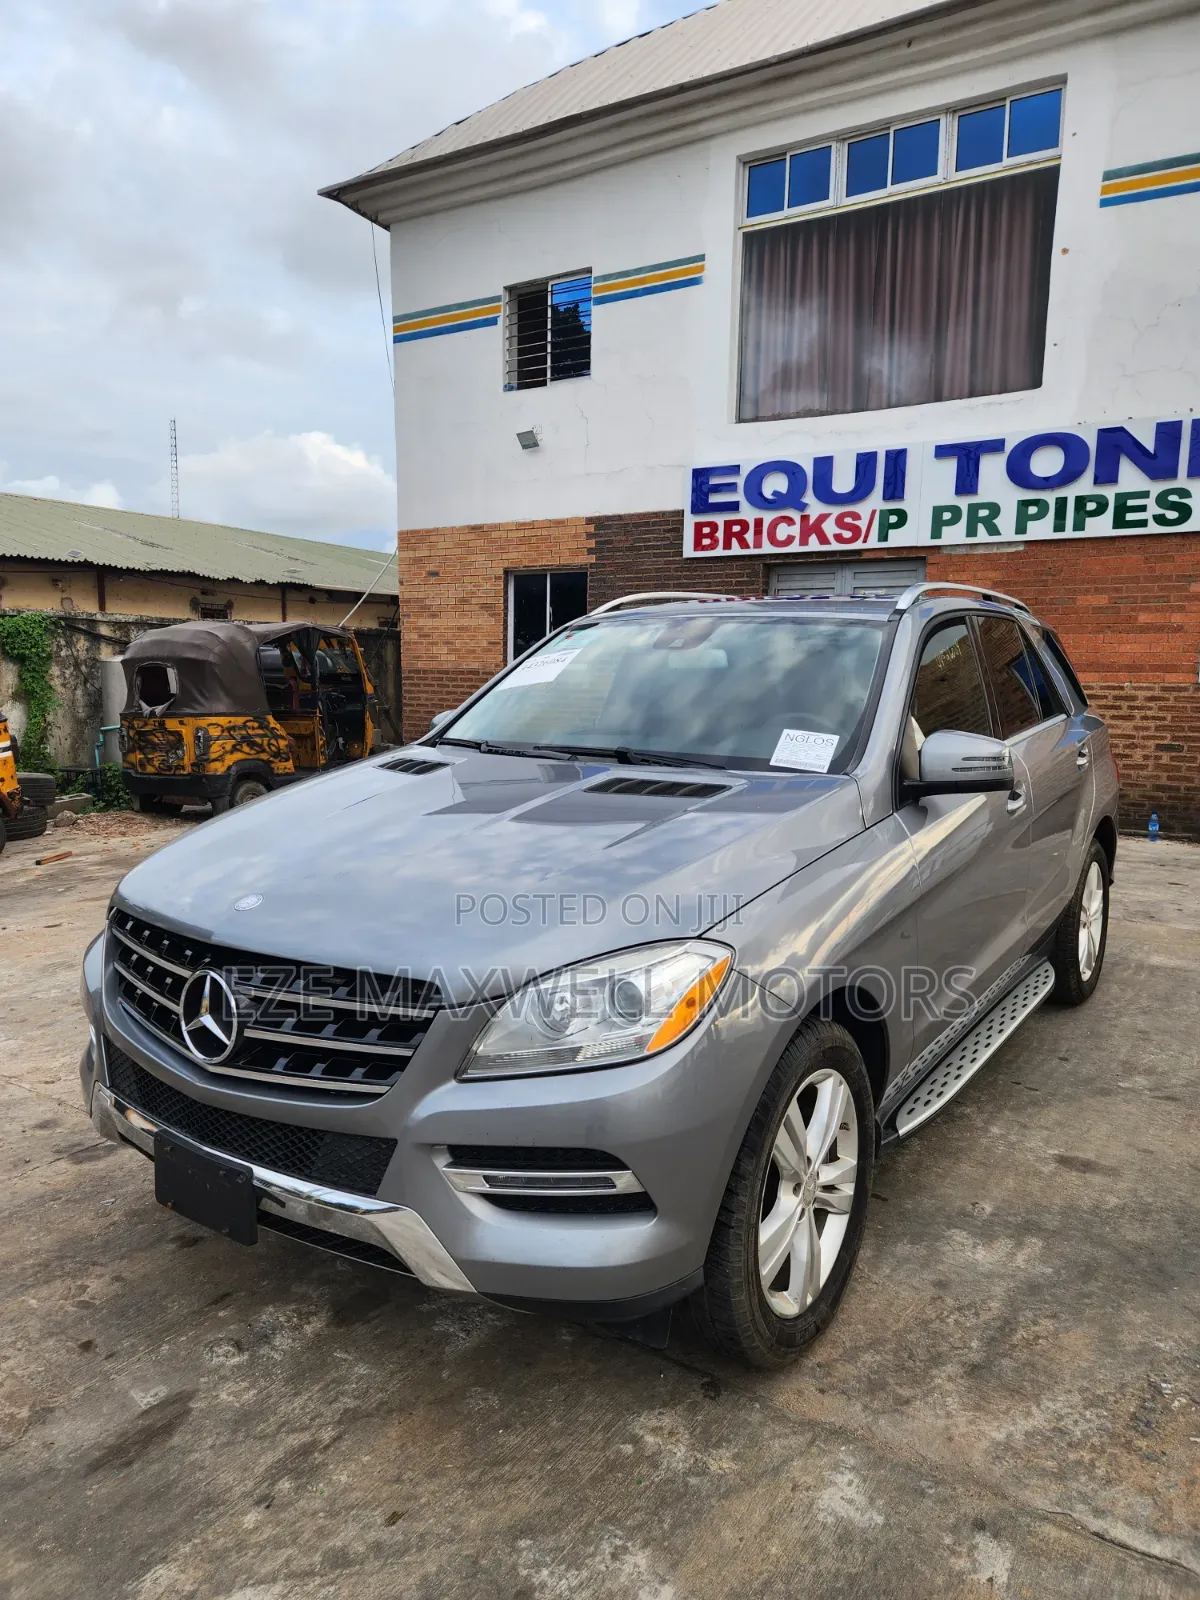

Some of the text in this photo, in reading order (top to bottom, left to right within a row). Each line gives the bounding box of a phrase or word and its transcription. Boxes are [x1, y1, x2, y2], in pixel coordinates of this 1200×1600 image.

[690, 417, 1200, 515] EQUI TON
[1013, 487, 1194, 536] PIPES
